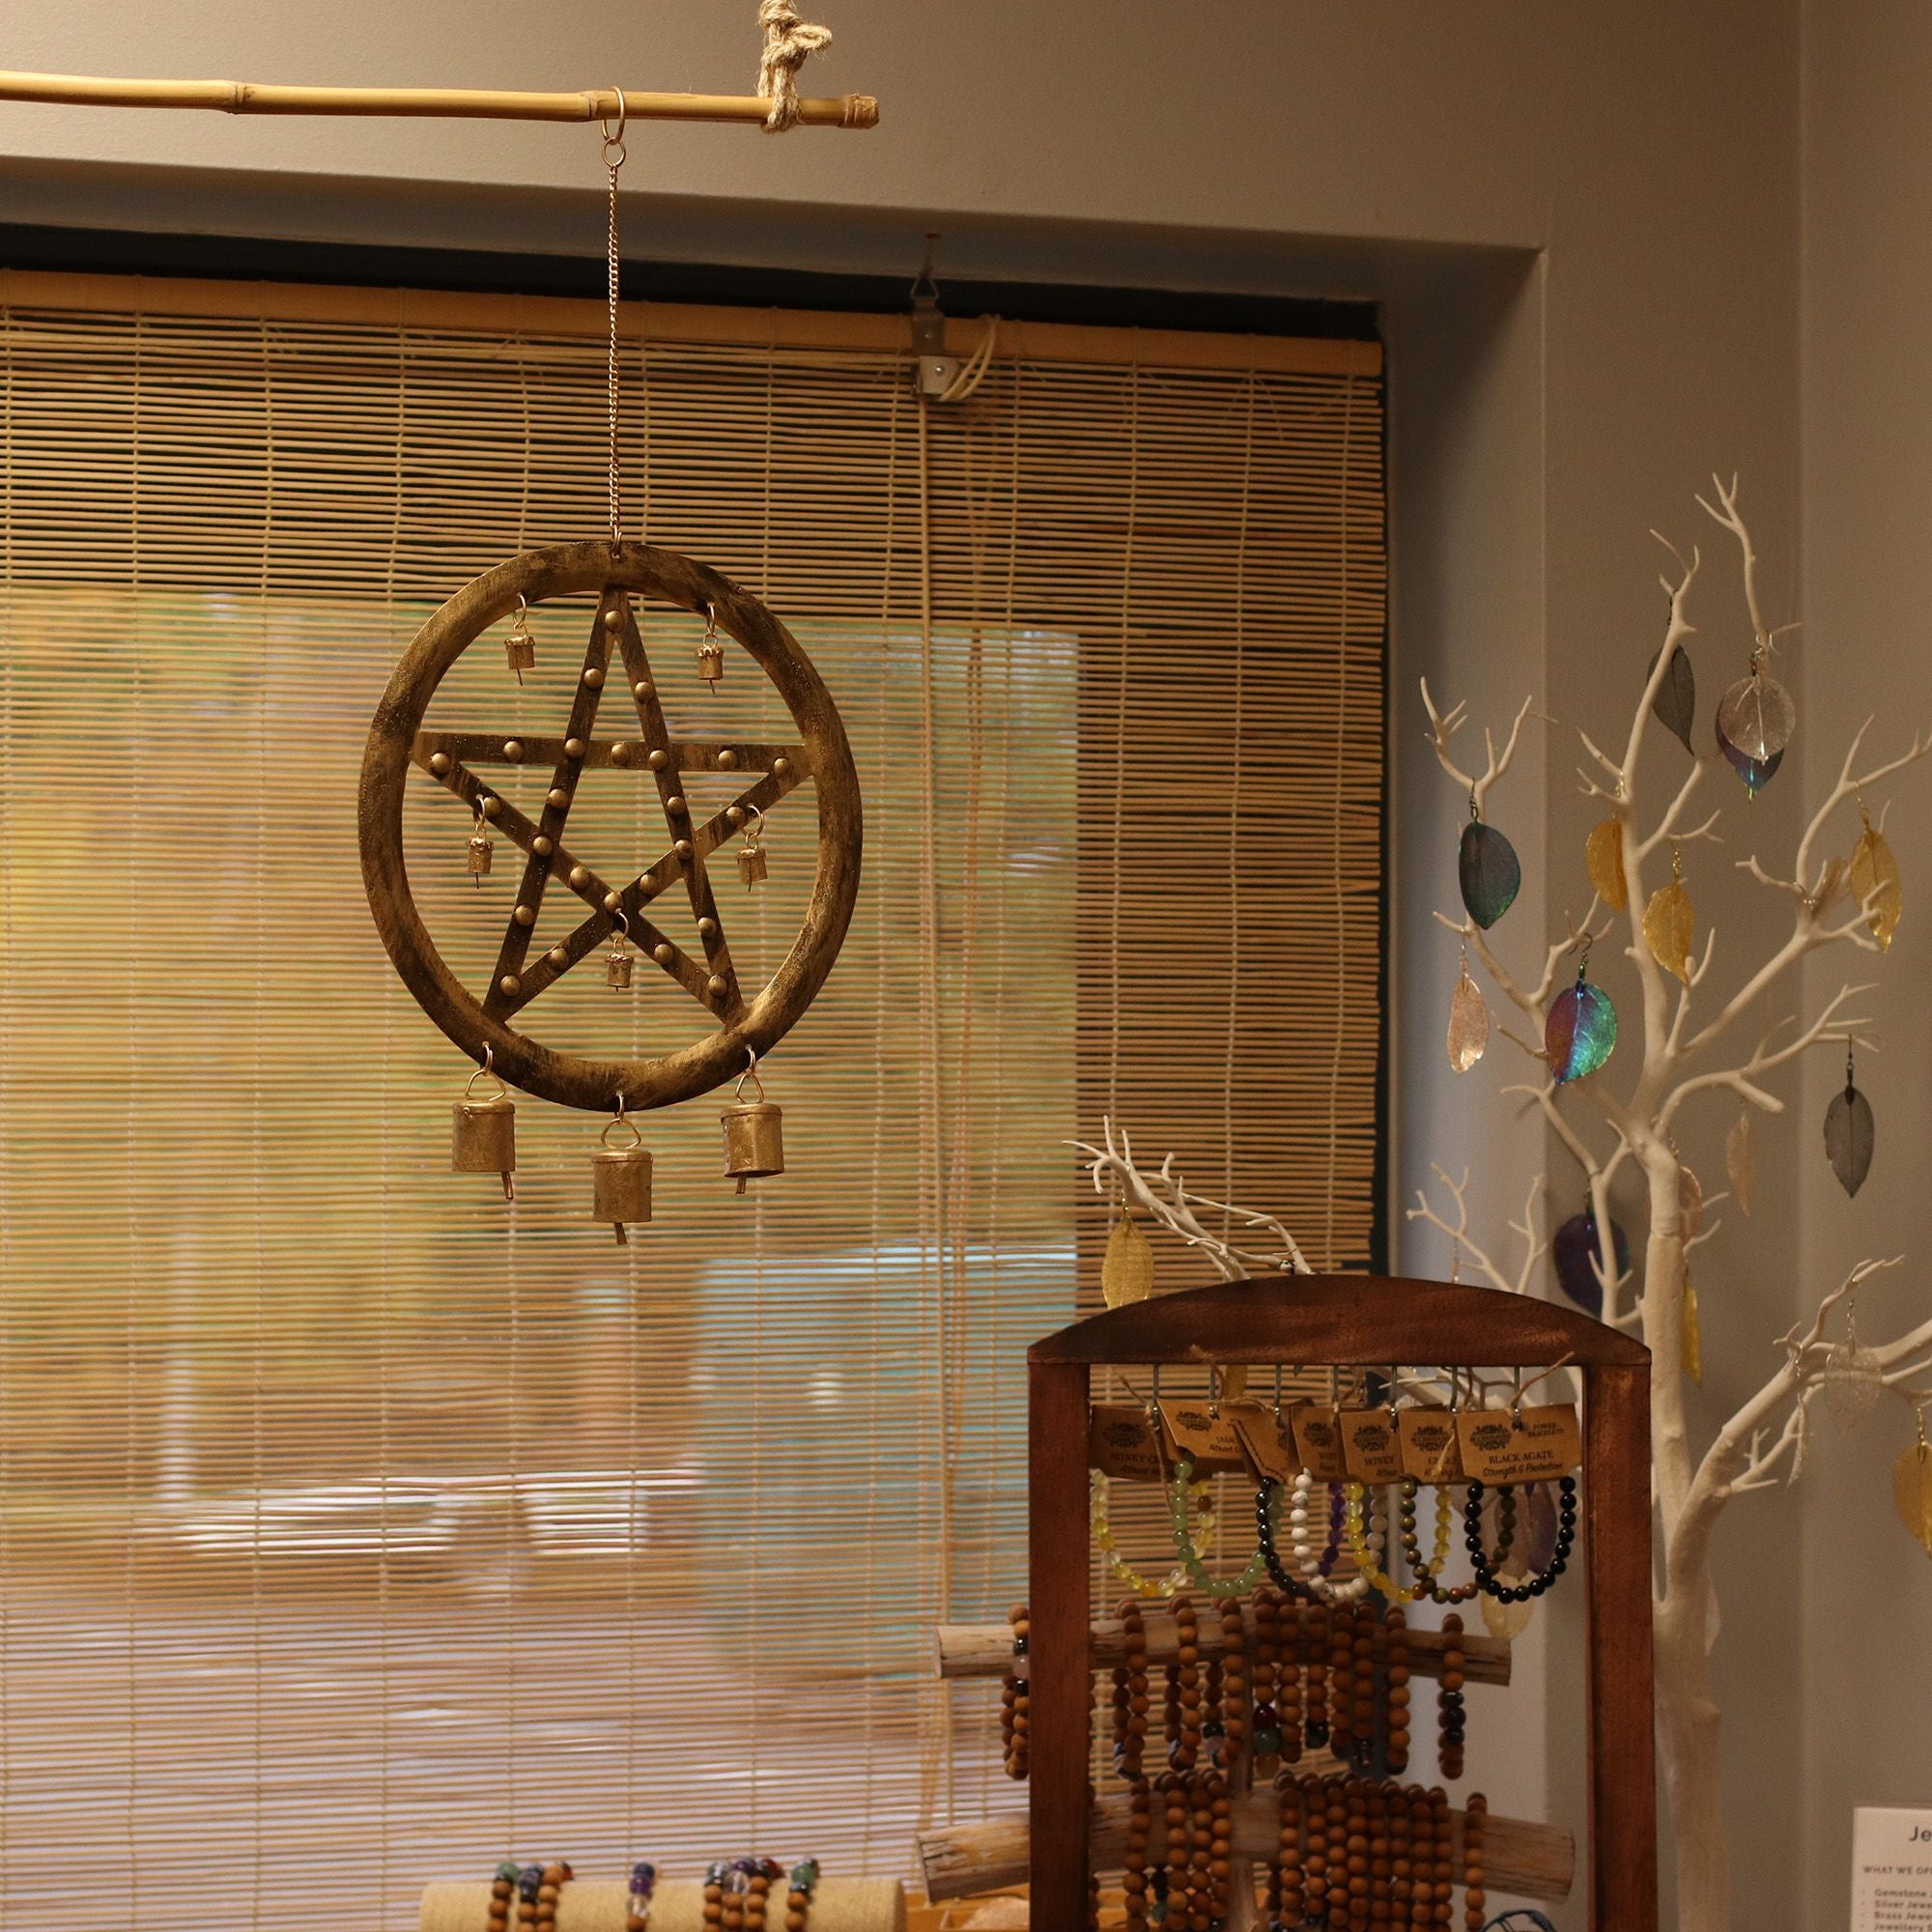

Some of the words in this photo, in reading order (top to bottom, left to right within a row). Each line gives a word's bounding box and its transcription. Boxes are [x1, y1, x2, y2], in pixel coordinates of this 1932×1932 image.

[1364, 1456, 1394, 1466] HONEY
[1489, 1453, 1520, 1464] BLACK
[1522, 1450, 1554, 1462] AGATE
[1482, 1465, 1517, 1480] Strength
[1525, 1462, 1564, 1473] Protection
[1896, 1866, 1913, 1875] WE
[1874, 1889, 1927, 1897] Gemstone
[1874, 1900, 1904, 1909] Silver
[1874, 1911, 1902, 1919] Brass
[1874, 1922, 1924, 1932] Jewellery
